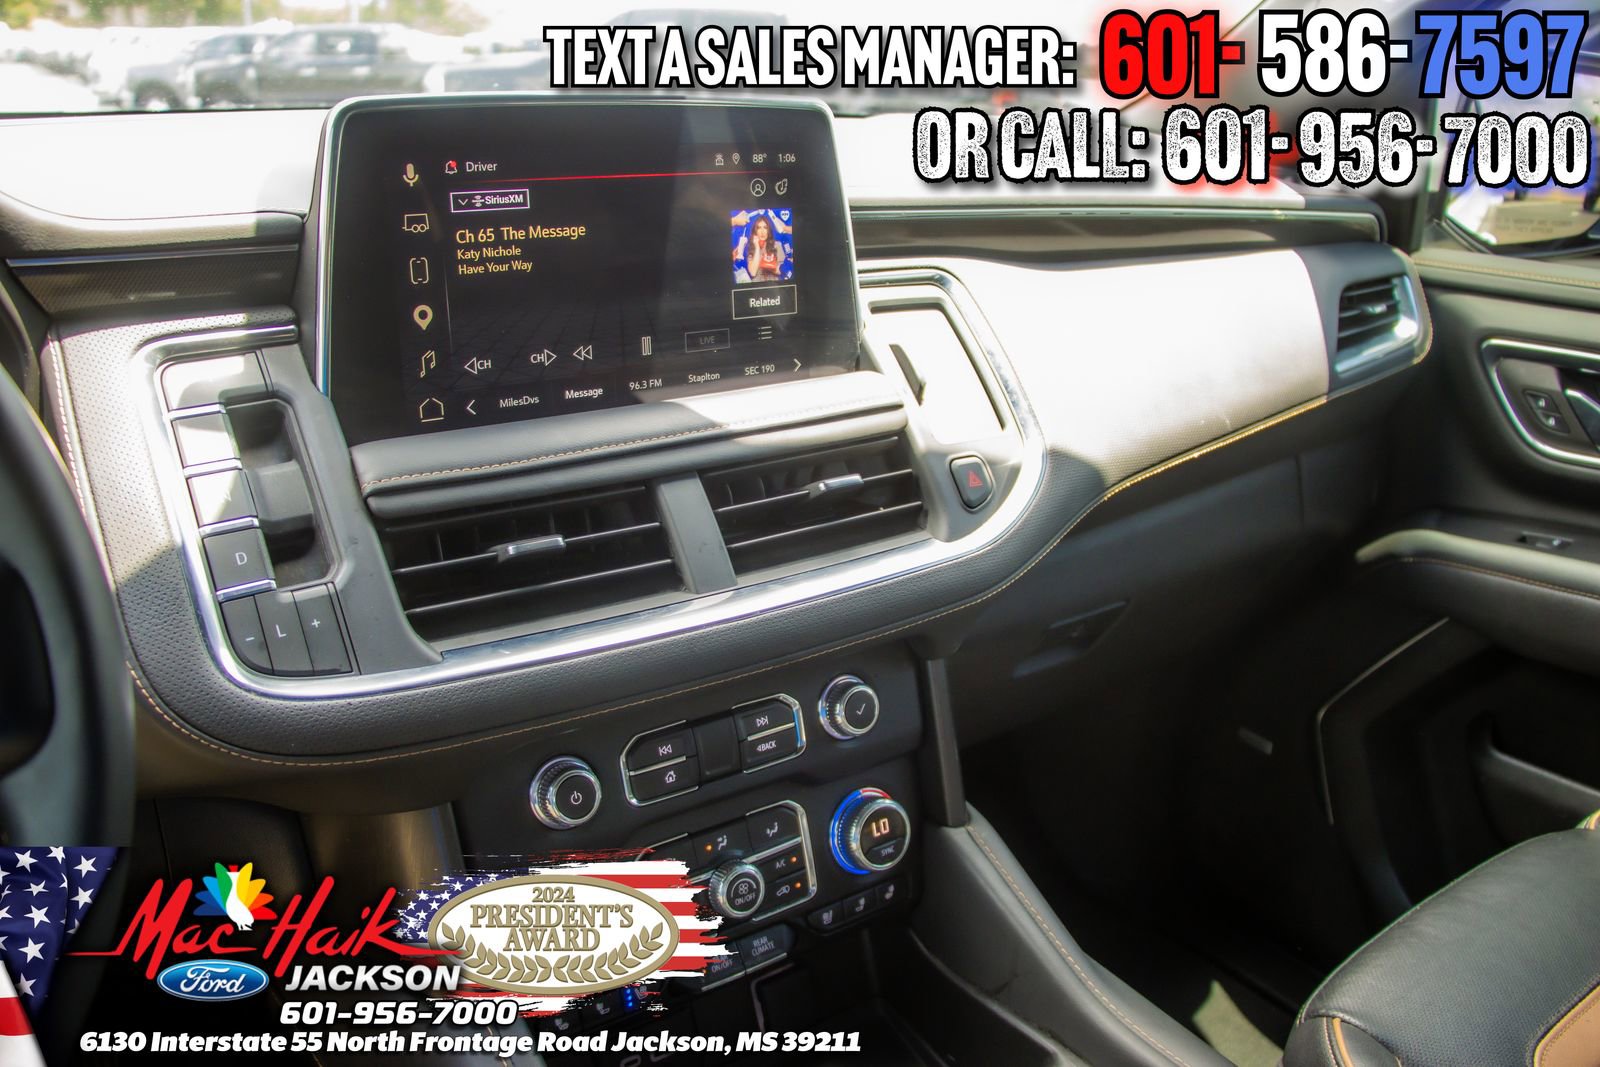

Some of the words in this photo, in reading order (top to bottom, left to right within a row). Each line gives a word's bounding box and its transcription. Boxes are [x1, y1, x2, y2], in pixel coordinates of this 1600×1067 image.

[778, 153, 796, 163] 1:06
[466, 161, 498, 172] Driver
[485, 194, 524, 205] SiriusXM
[456, 229, 475, 244] Ch
[478, 227, 495, 243] 65
[500, 226, 526, 241] The
[529, 225, 586, 240] Message
[457, 247, 480, 261] Katy
[483, 245, 521, 258] Nichole
[458, 264, 485, 275] Have
[486, 262, 510, 274] Your
[511, 260, 533, 272] Way
[749, 296, 781, 308] Related
[700, 336, 715, 345] LIVE
[477, 359, 492, 370] CH
[530, 353, 545, 364] CH
[745, 366, 760, 376] SEC
[761, 364, 775, 375] 190
[688, 371, 720, 384] Staplton
[629, 380, 648, 391] 96.3
[649, 379, 663, 389] FM
[565, 387, 604, 400] Message
[500, 395, 540, 409] MilesDvs
[235, 551, 247, 565] D
[275, 624, 286, 638] L
[761, 740, 777, 752] BACK
[872, 817, 890, 838] LO
[881, 845, 896, 857] SYNC
[775, 858, 786, 870] A/C
[734, 893, 757, 906] ON/OFF
[752, 935, 769, 949] REAR
[751, 941, 776, 957] CLIMATE
